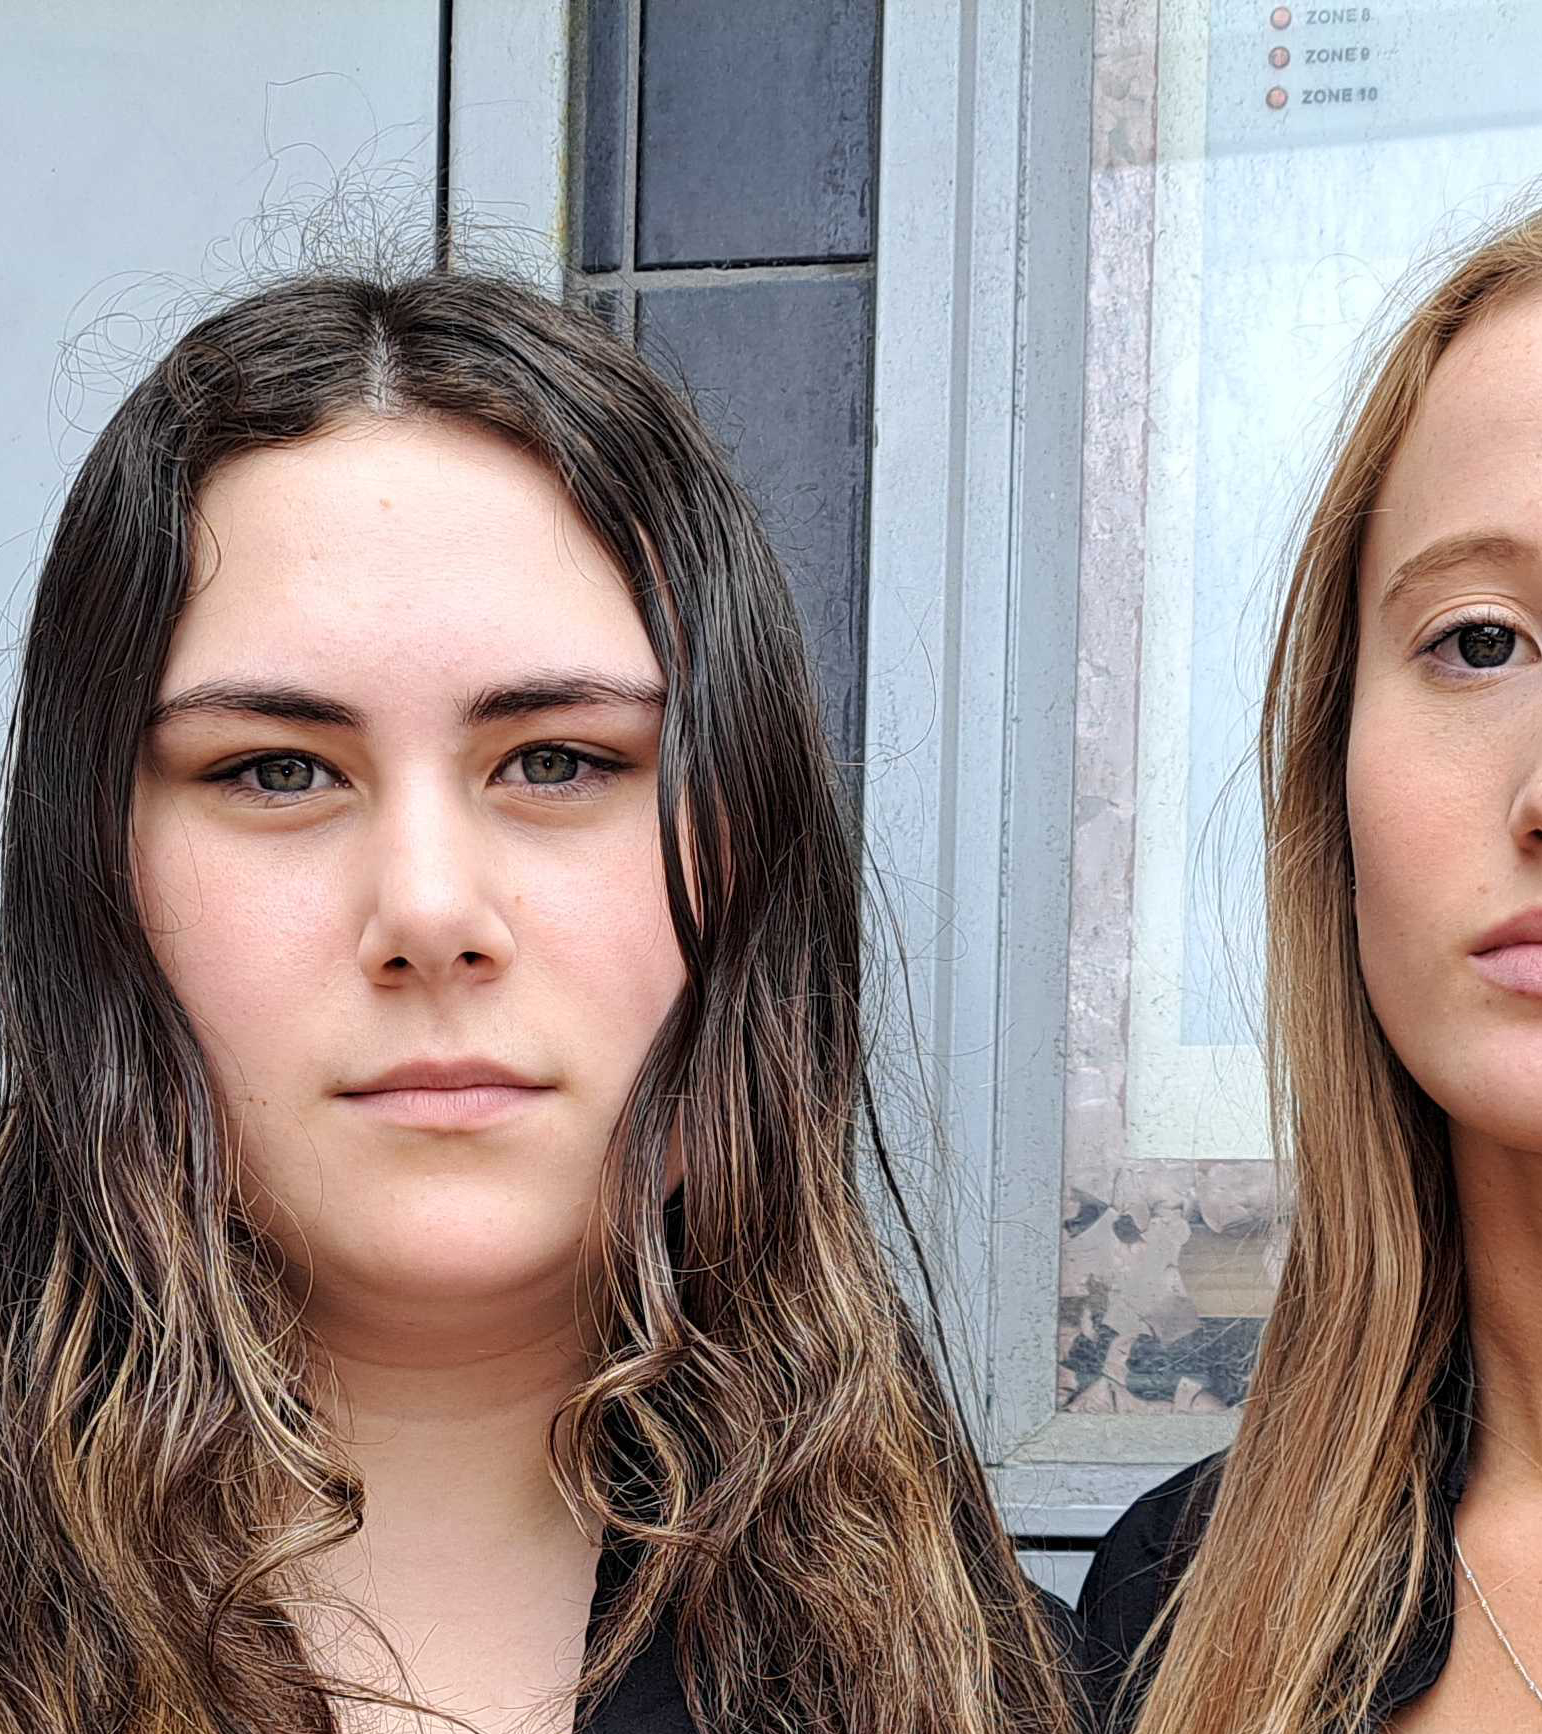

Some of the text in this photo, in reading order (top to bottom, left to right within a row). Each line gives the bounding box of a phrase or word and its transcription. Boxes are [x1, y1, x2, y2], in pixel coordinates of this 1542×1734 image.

[1305, 8, 1357, 24] ZONE
[1305, 46, 1370, 64] ZONE 9
[1301, 86, 1378, 104] ZONE 10
